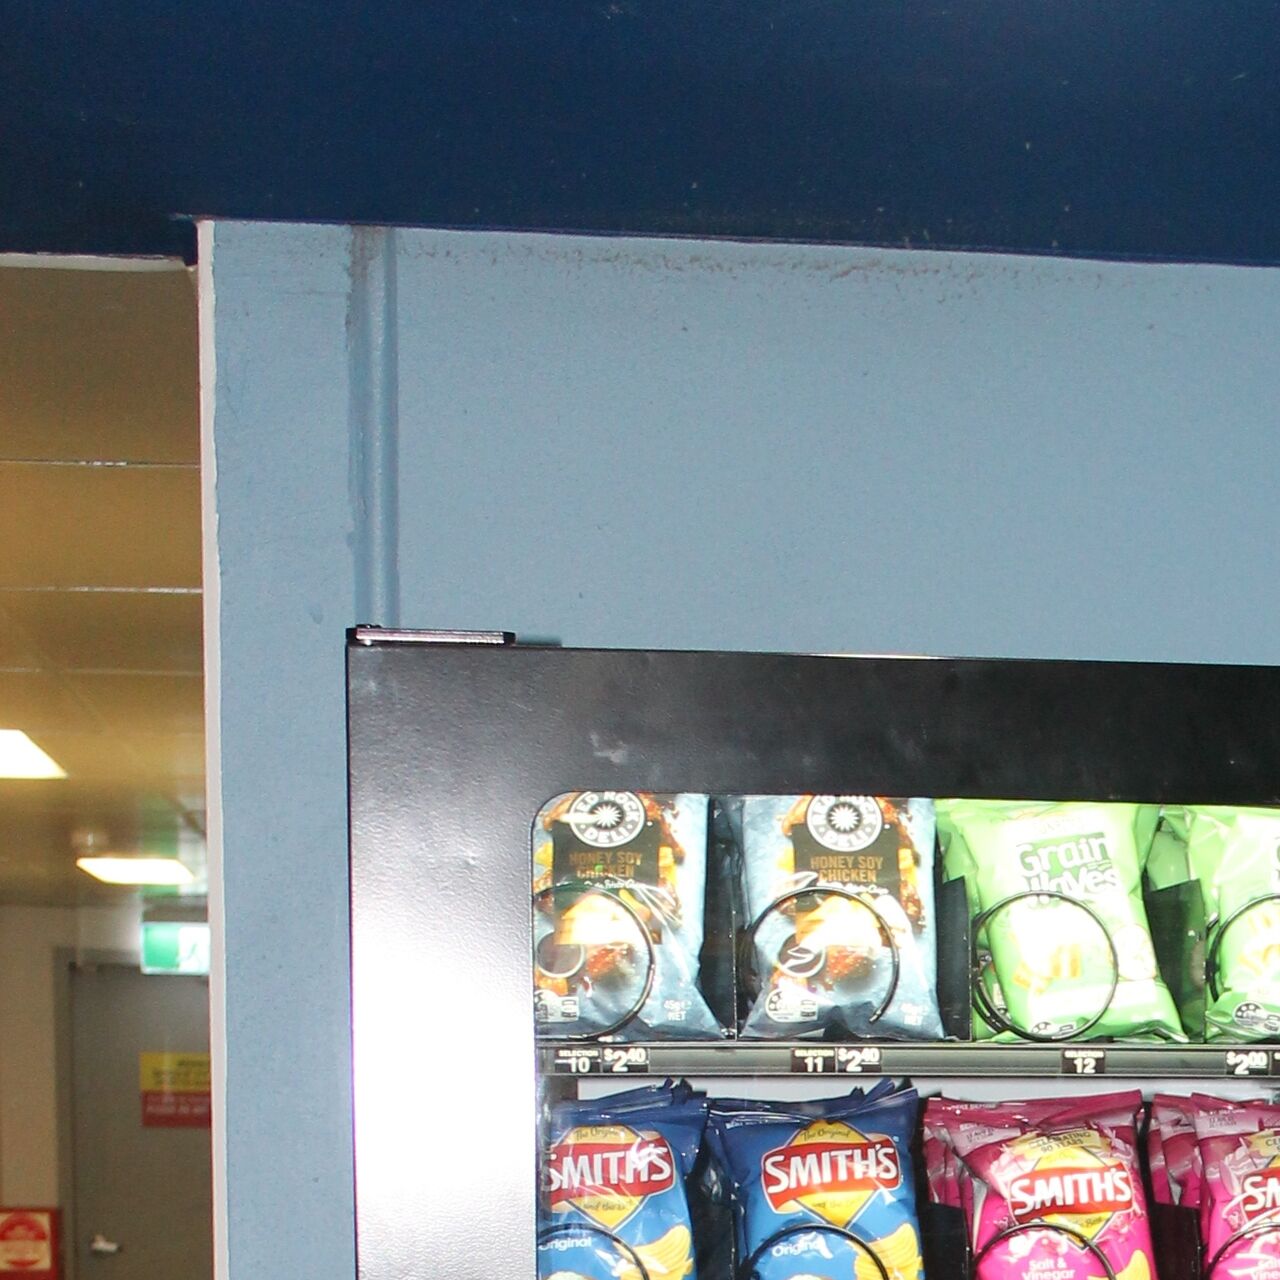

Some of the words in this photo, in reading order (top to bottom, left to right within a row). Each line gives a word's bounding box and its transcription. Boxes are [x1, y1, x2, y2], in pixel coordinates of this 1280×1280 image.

[569, 852, 612, 866] HONEY
[617, 853, 642, 866] SOY
[810, 856, 855, 870] HONEY
[857, 857, 883, 870] SOY
[1019, 836, 1112, 878] Grain
[819, 869, 877, 883] CHICKEN
[570, 1058, 591, 1073] 10
[804, 1057, 824, 1073] 11
[1073, 1058, 1096, 1074] 12
[764, 1143, 899, 1194] SMITH'S
[1011, 1167, 1133, 1216] SMITH'S
[1029, 1258, 1055, 1271] Salt
